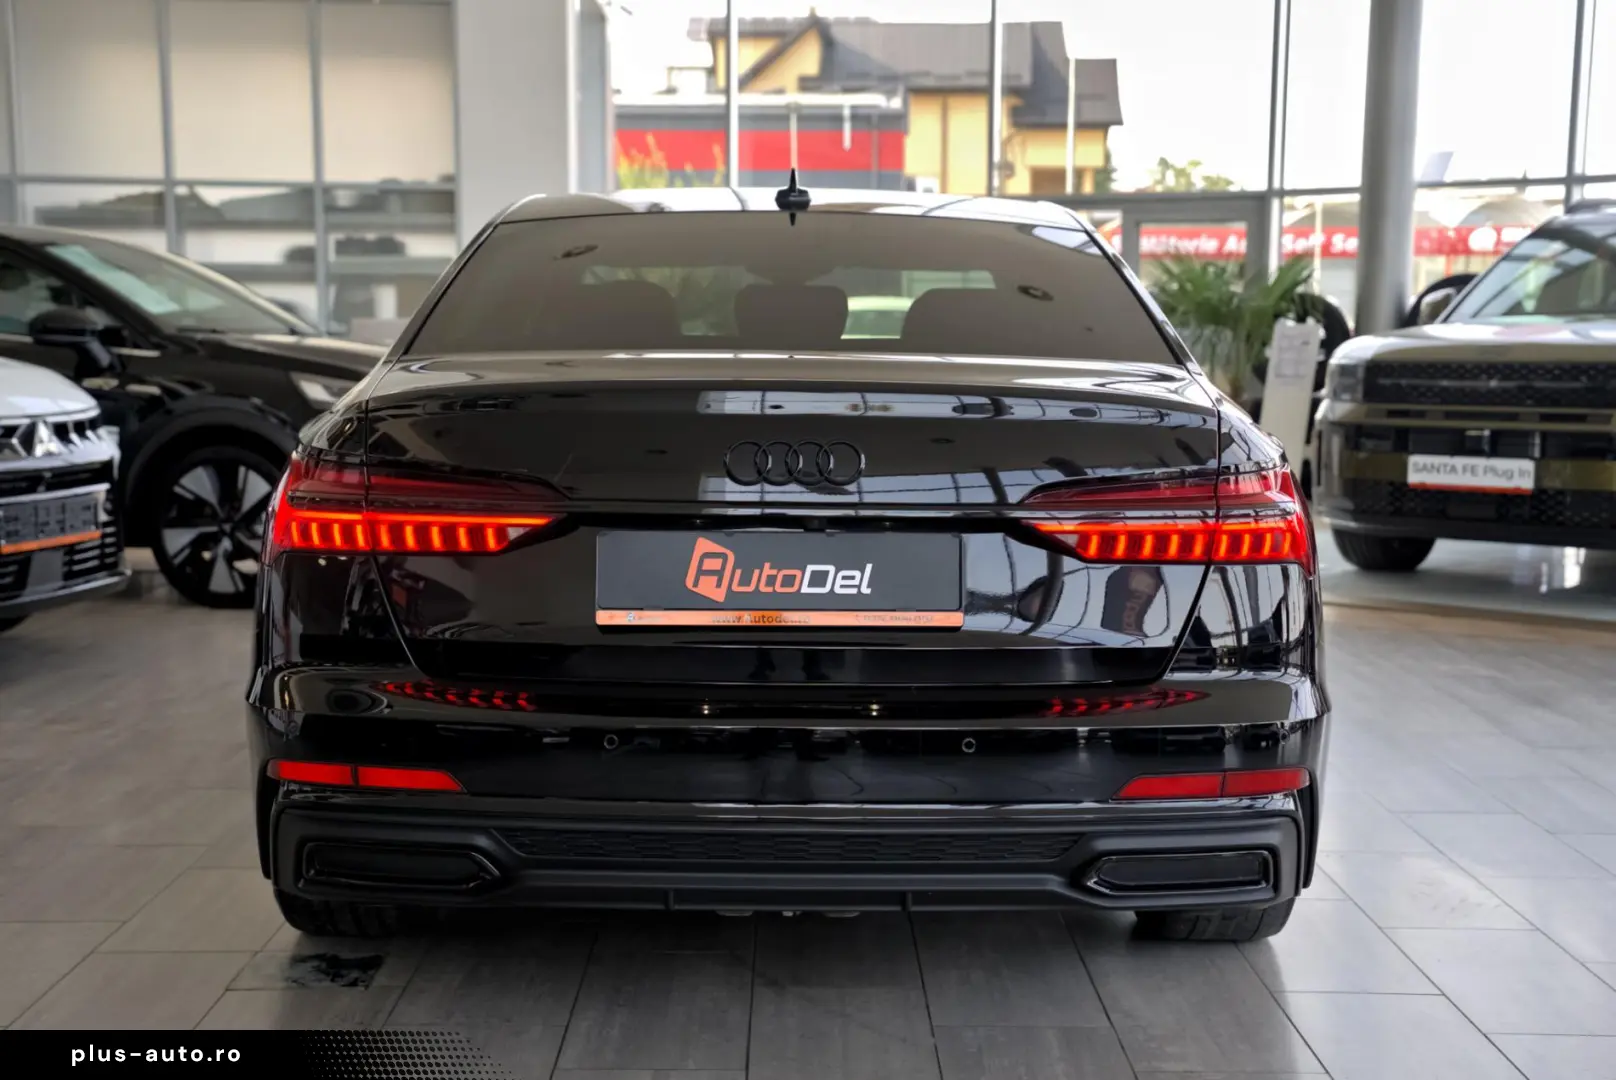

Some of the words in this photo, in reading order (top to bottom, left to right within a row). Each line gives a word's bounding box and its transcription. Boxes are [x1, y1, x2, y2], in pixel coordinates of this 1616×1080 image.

[1411, 460, 1459, 476] SANTA
[1461, 463, 1480, 478] FE
[1483, 464, 1515, 481] Plug
[1518, 464, 1532, 479] In
[685, 537, 873, 602] AutoDel
